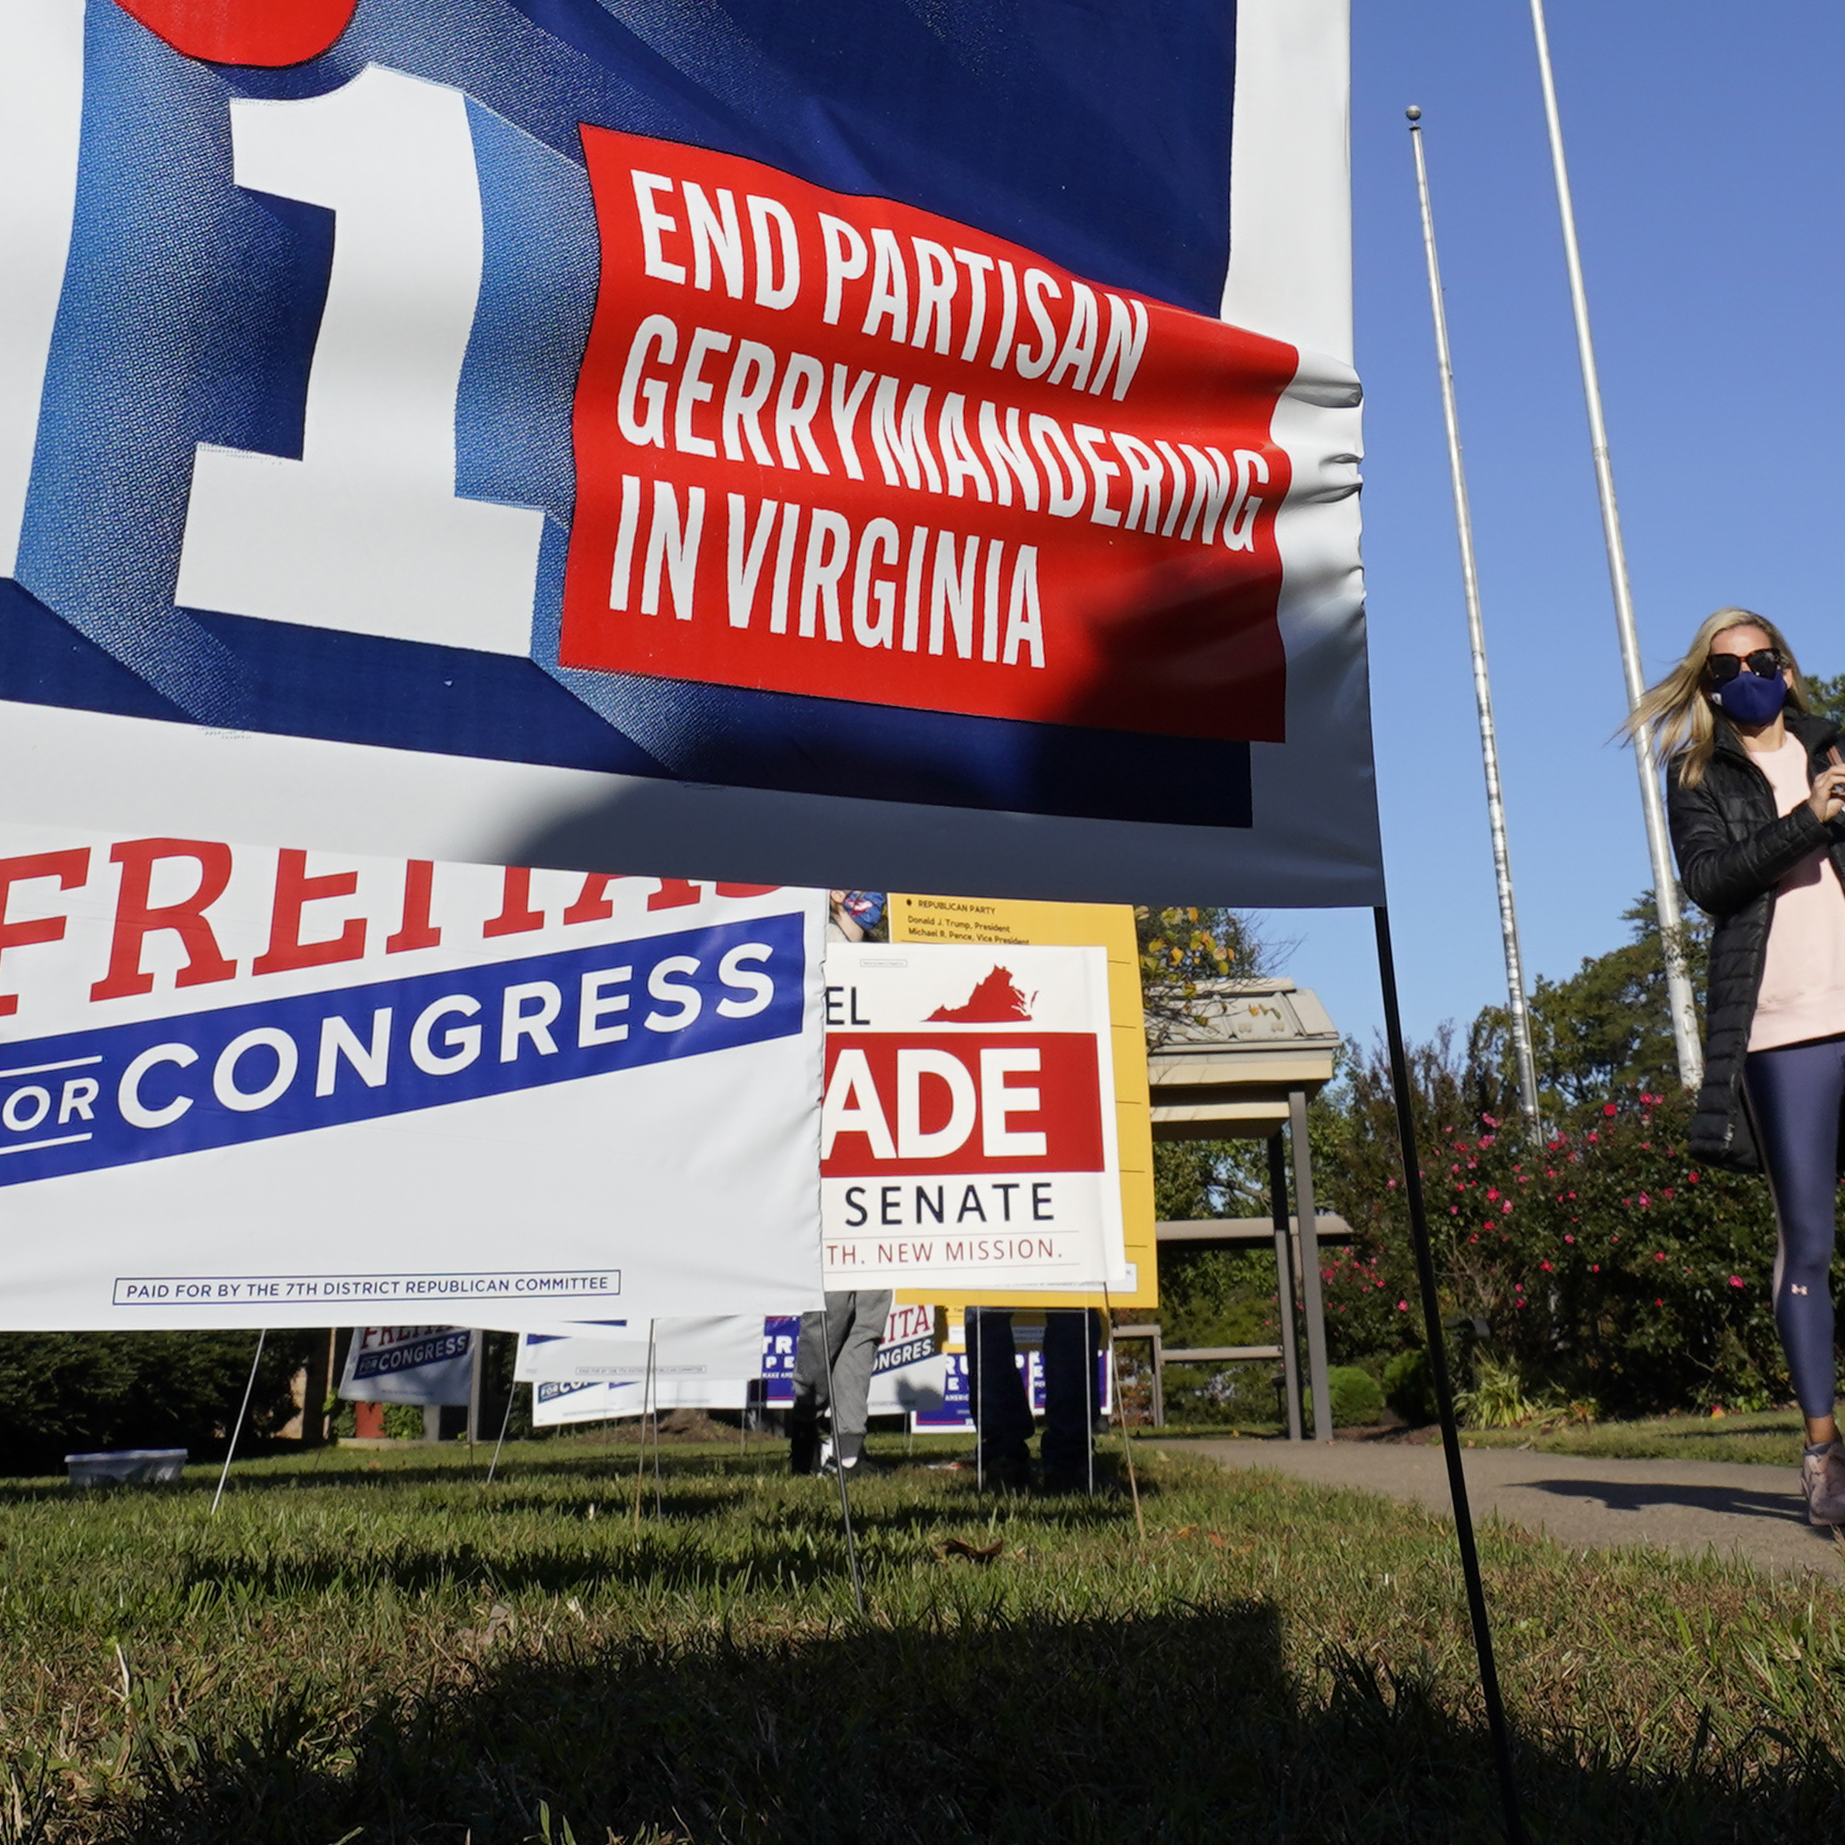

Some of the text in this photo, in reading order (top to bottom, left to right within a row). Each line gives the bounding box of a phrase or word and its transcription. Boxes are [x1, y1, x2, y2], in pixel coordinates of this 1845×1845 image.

[629, 169, 1150, 403] END PARTISAN
[175, 63, 545, 657] 1
[617, 312, 1271, 554] GERRYMANDERING
[608, 475, 1047, 669] IN VIRGINIA
[907, 915, 935, 926] Donald
[974, 922, 1011, 933] President
[918, 899, 996, 915] REPUBLICAN PARTY
[908, 927, 938, 938] Michael
[976, 933, 993, 943] Vice
[825, 986, 871, 1025] EL
[117, 941, 777, 1129] CONGRESS
[820, 1047, 1048, 1160] ADE
[844, 1181, 1054, 1227] SENATE
[826, 1238, 1063, 1266] TH. NEW MISSION.
[126, 1277, 609, 1298] PAID FOR BY THE 7TH DISTRICT REPUBLICAN COMMITTEE
[378, 1335, 467, 1371] CONGRESS
